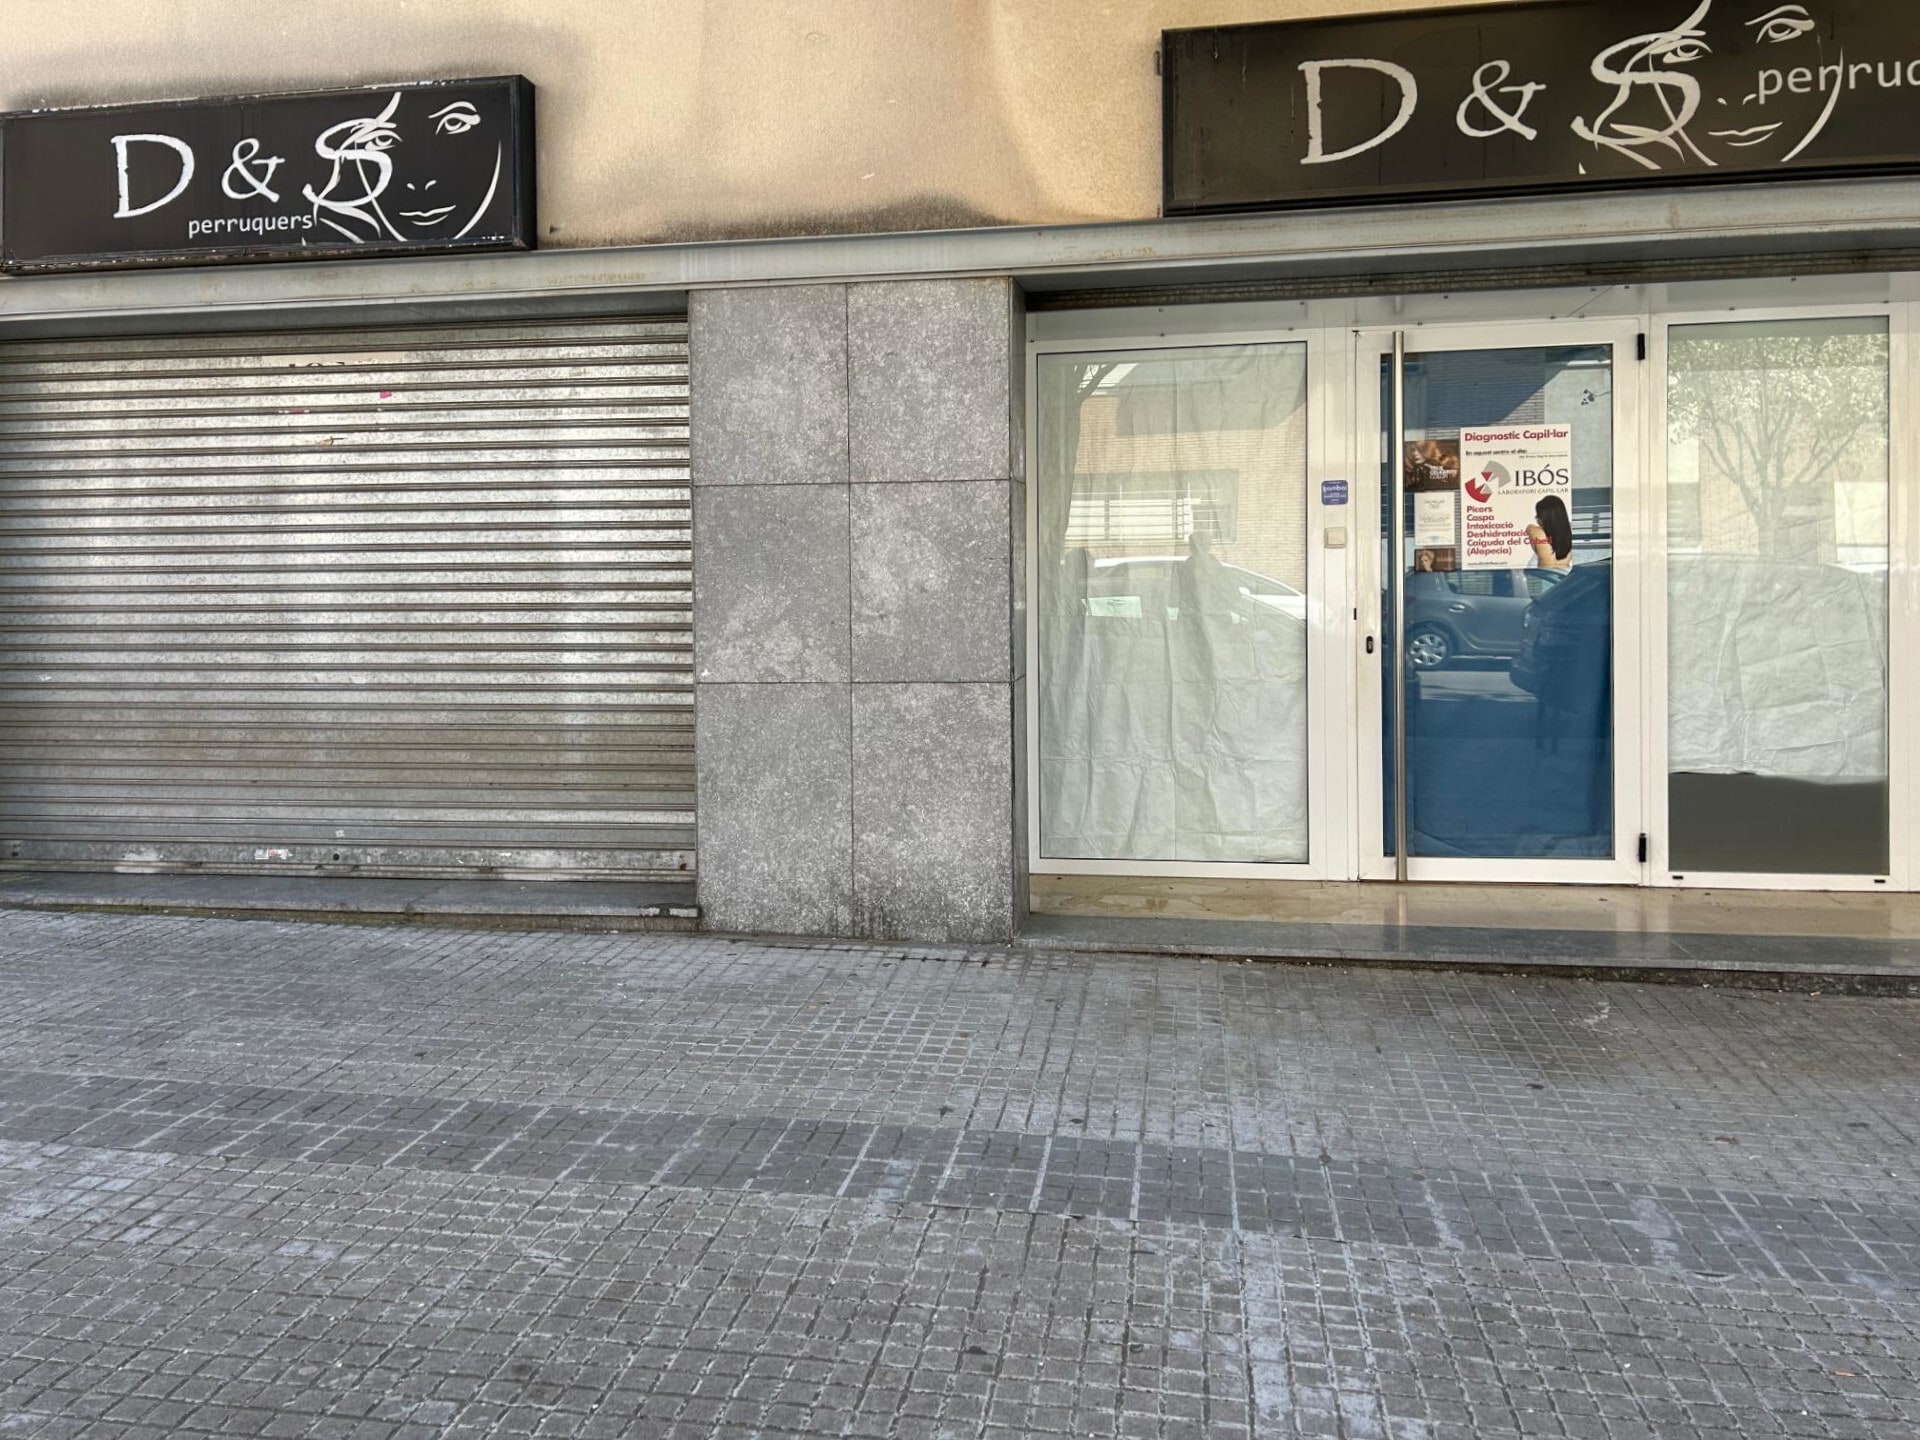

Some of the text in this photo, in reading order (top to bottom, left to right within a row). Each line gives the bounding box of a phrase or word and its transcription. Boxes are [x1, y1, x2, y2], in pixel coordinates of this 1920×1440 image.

[1298, 58, 1417, 164] D
[1455, 59, 1546, 141] &
[111, 133, 194, 218] D
[221, 137, 285, 203] &
[188, 211, 313, 238] perruquers
[1515, 463, 1569, 487] IBÓS
[1467, 505, 1493, 513] Picors
[1466, 514, 1494, 522] Caspa
[1467, 539, 1504, 547] Caiguda
[1507, 538, 1521, 546] del
[1467, 547, 1512, 556] (Alopecia)
